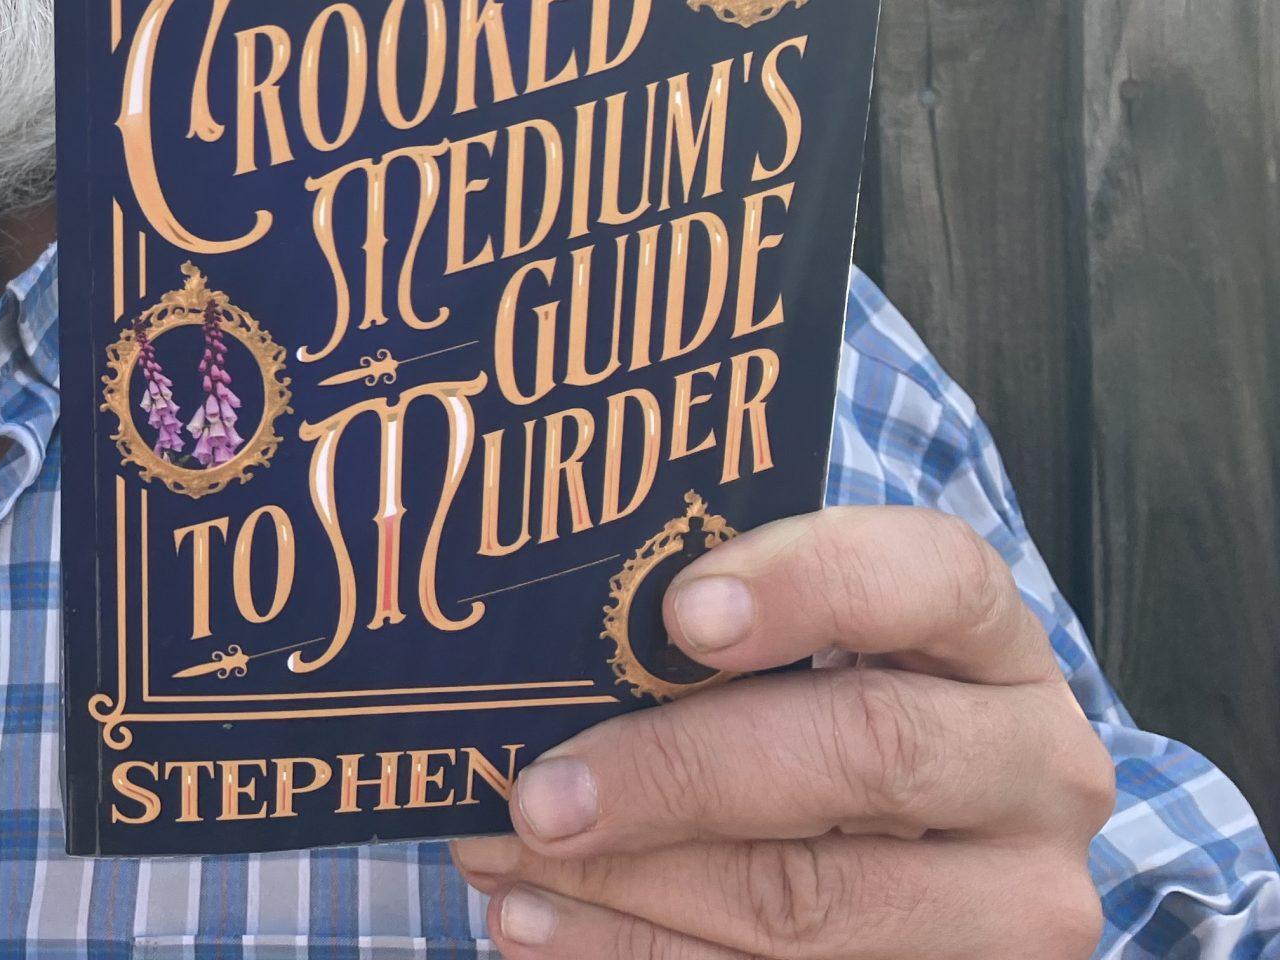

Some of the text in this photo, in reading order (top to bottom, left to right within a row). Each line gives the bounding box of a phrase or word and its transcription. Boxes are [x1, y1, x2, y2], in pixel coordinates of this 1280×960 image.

[296, 34, 809, 365] MEDIUM'S
[493, 182, 797, 406] GUIDE
[172, 347, 783, 674] TO MURDER
[111, 743, 526, 825] STEPHEN
